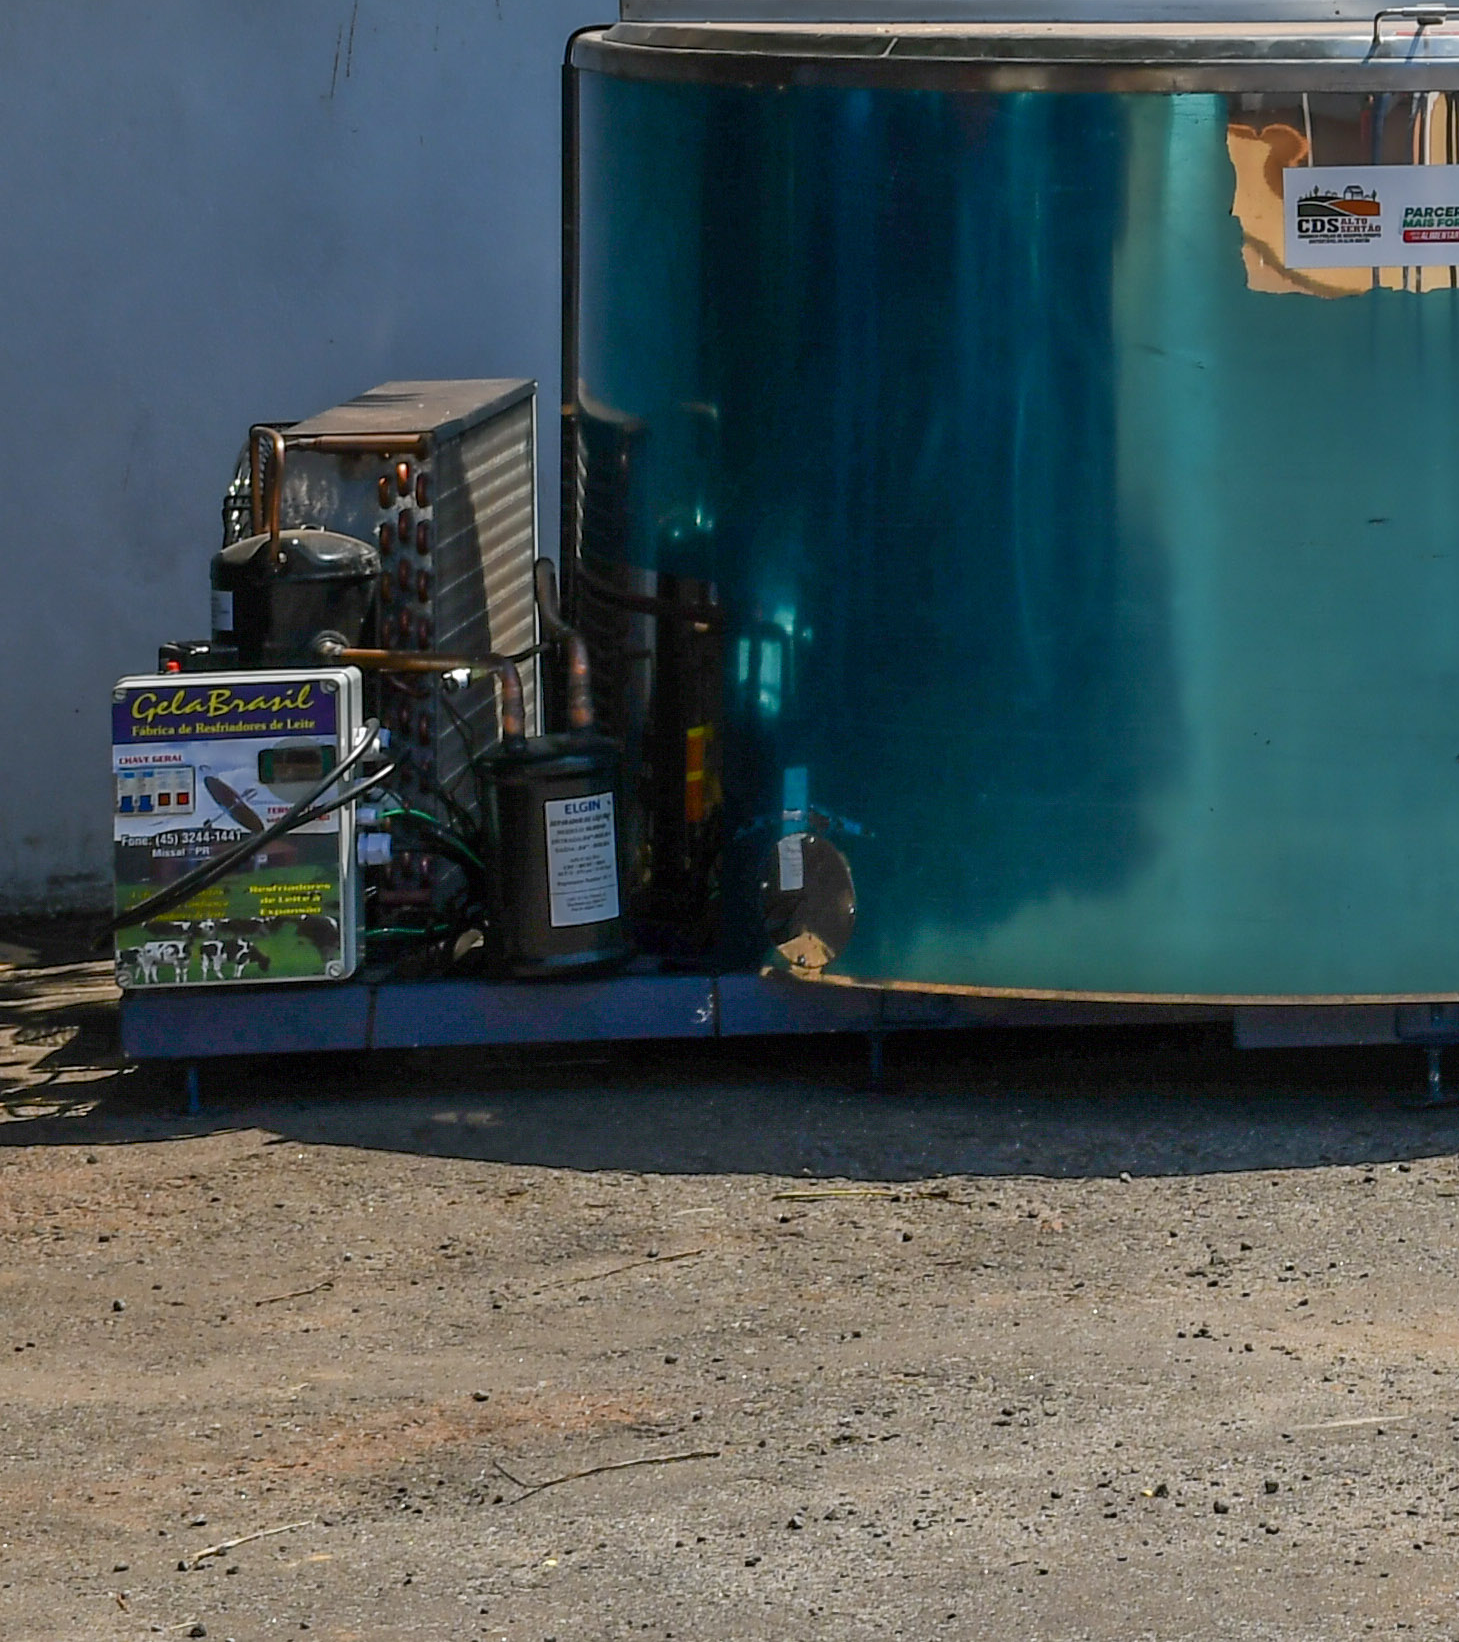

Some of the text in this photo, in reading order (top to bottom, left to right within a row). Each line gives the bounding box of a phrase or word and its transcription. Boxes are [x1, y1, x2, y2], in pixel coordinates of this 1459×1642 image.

[1298, 218, 1339, 233] CDS
[1340, 223, 1381, 233] SERTÃO
[1402, 218, 1434, 228] MAIS
[132, 718, 316, 737] Fábrica de Resfriadores de Leite
[564, 798, 600, 815] ELGIN
[155, 833, 178, 846] (45)
[182, 830, 242, 844] 3244-1441
[152, 847, 186, 858] Missal
[195, 846, 210, 856] PR
